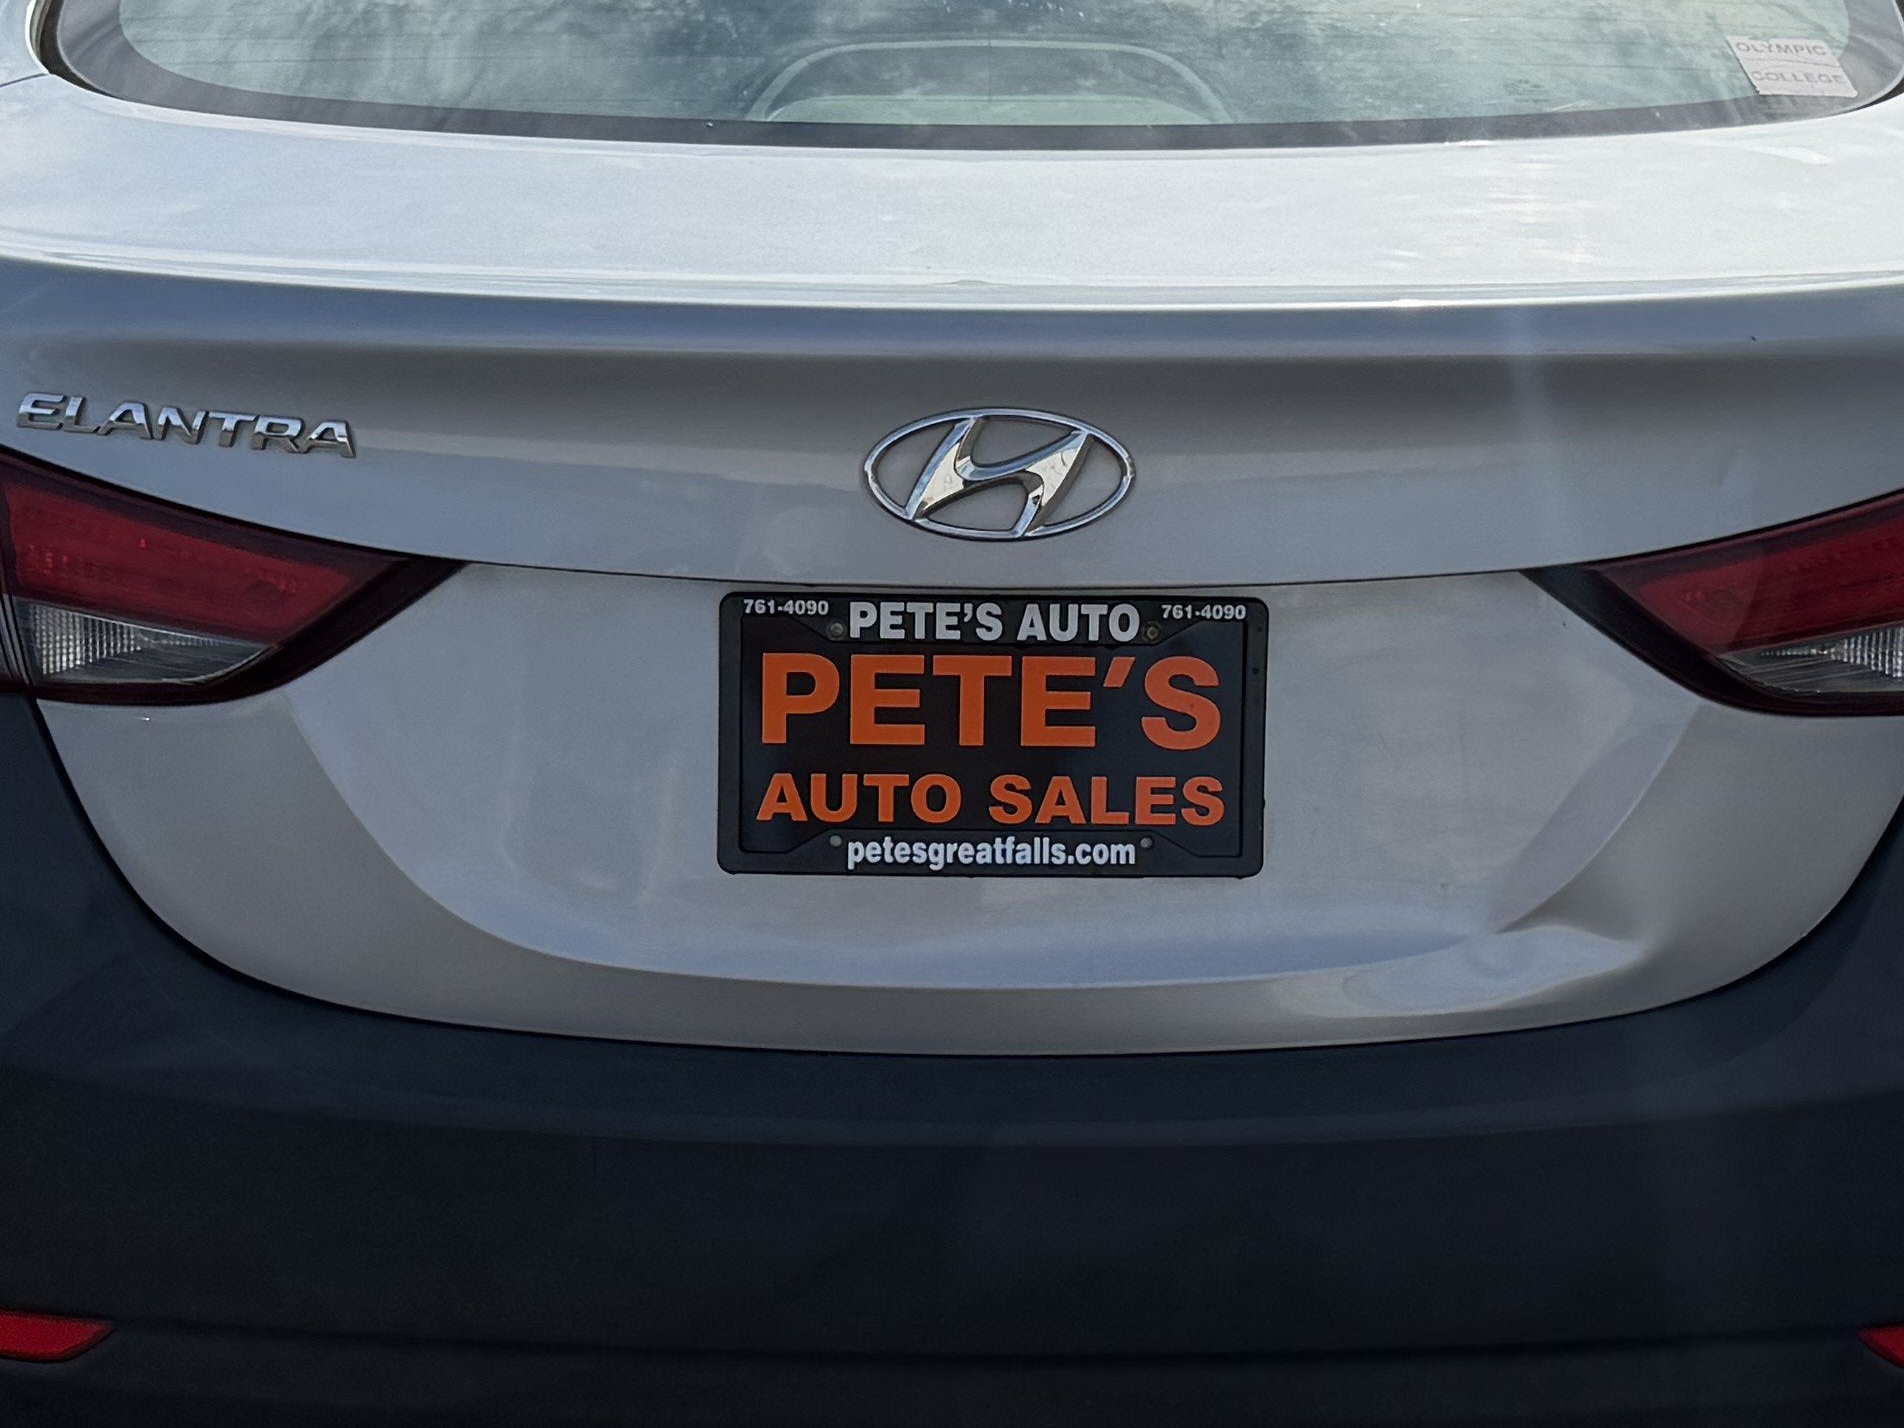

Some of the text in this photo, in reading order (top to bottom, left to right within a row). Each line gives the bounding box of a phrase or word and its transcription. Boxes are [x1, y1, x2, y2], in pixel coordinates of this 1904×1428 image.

[1735, 41, 1827, 56] OLYMPIC
[17, 391, 357, 458] ELANTRA
[743, 598, 830, 615] 761-4090
[849, 601, 1140, 642] PETE'S AUTO
[1161, 604, 1247, 620] 761-4090
[762, 653, 1221, 750] PETE'S
[757, 773, 1226, 826] AUTO SALES
[847, 835, 1136, 871] petesgreatfalls.com
